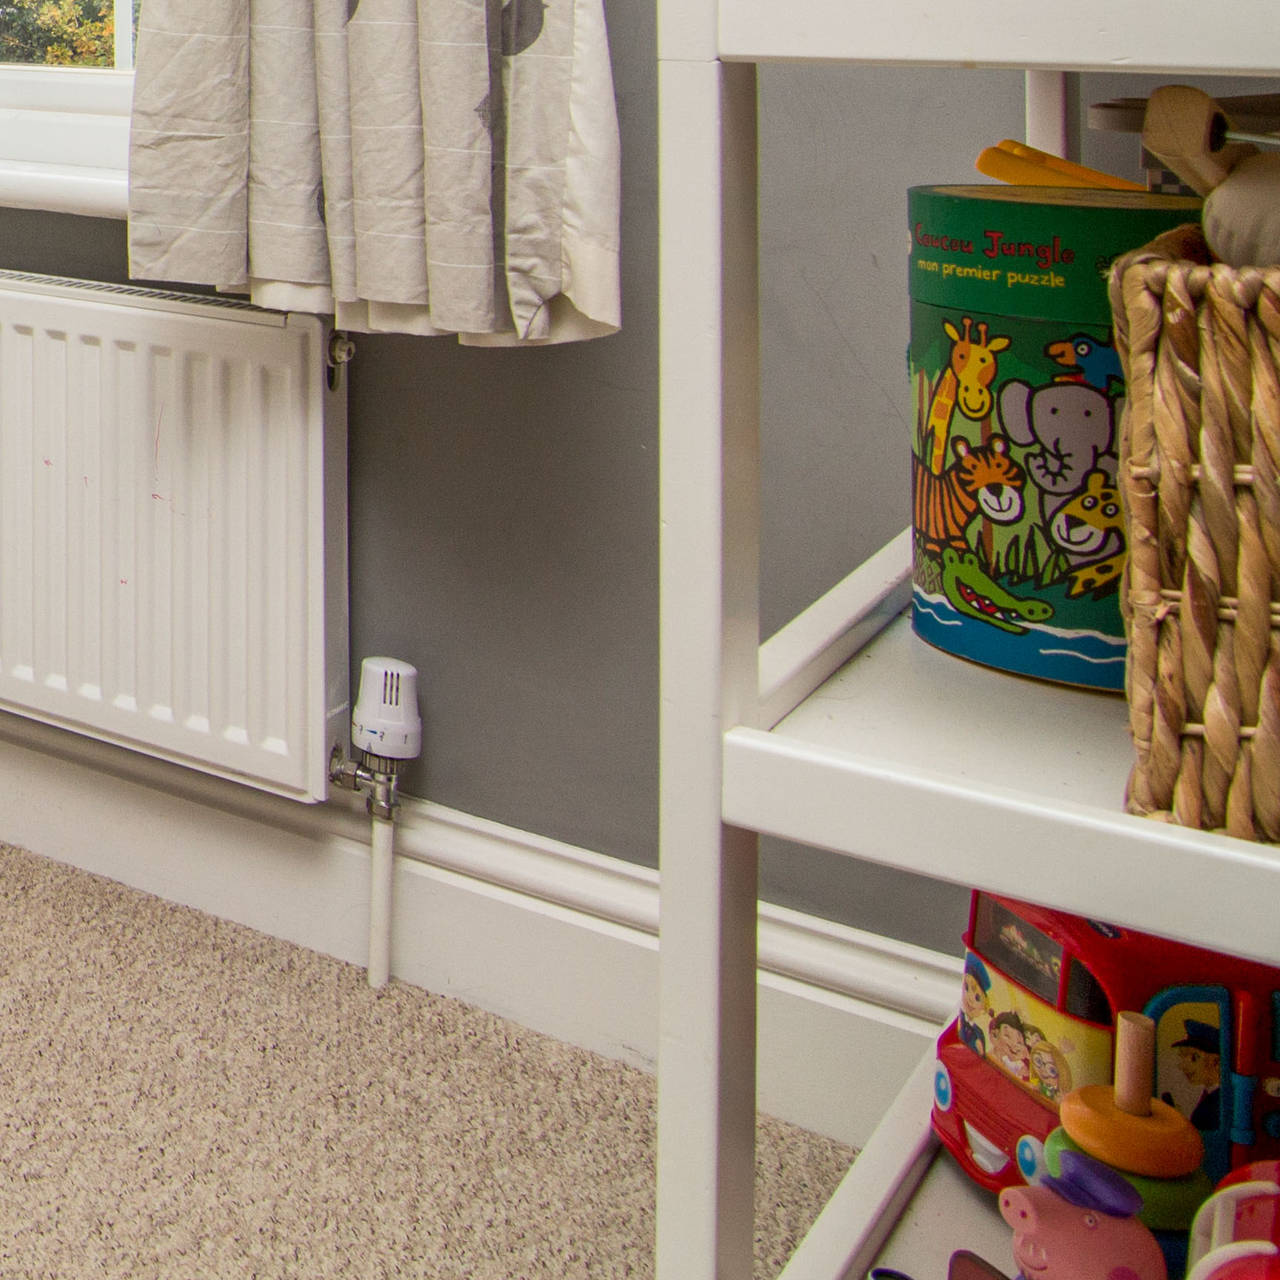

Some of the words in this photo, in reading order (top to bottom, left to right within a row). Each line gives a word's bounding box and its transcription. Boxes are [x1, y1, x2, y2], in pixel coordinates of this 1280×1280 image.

[915, 223, 974, 253] Coucou
[983, 229, 1076, 269] Jungle
[917, 259, 938, 271] mon
[942, 263, 1001, 281] premier
[1007, 271, 1065, 288] puzzle
